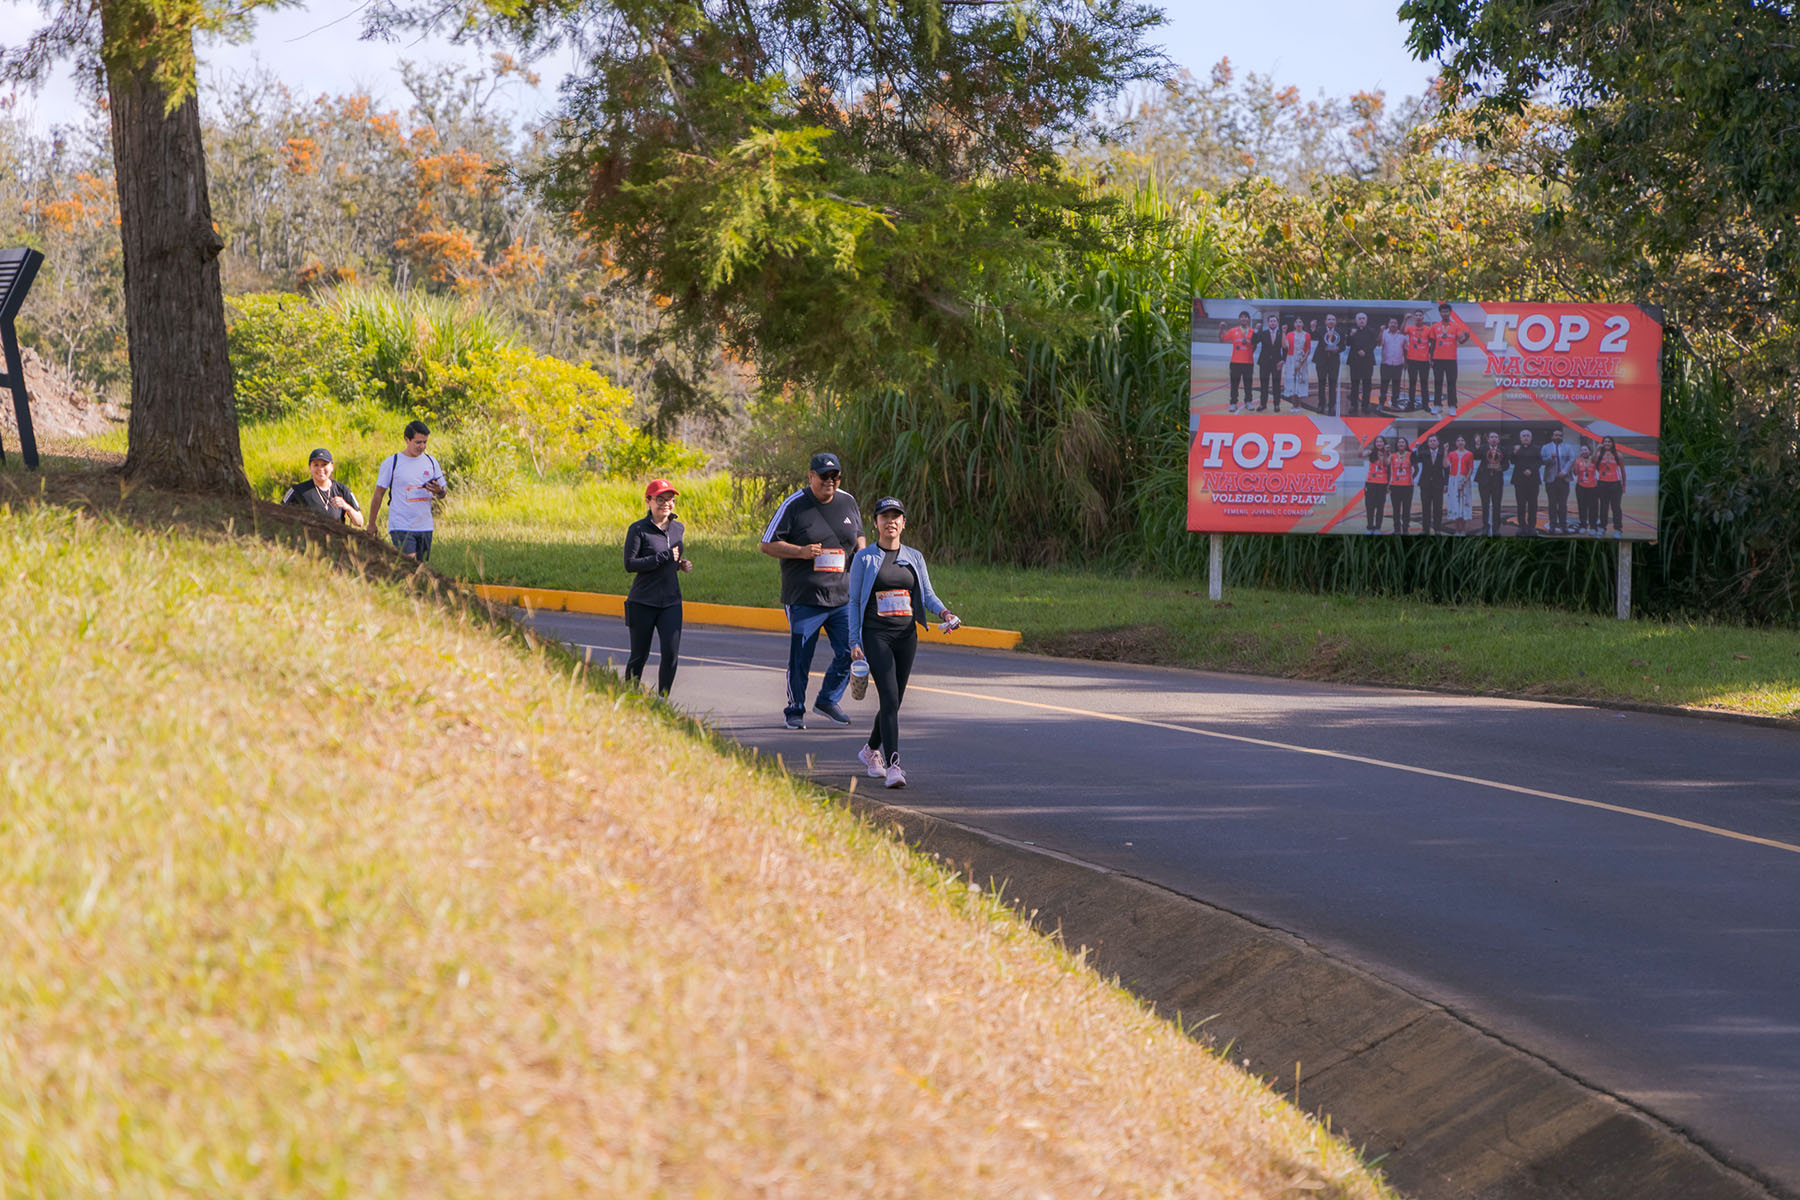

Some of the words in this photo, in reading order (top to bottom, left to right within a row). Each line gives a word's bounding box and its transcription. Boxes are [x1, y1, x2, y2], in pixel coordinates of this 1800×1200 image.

[1484, 313, 1590, 352] TOP
[1599, 315, 1630, 353] 2
[1484, 355, 1625, 378] NACIONAL
[1495, 378, 1555, 388] VOLEIBOL
[1558, 379, 1574, 388] DE
[1576, 379, 1615, 389] PLAYA
[1201, 431, 1302, 469] TOP
[1312, 433, 1343, 470] 3
[1200, 472, 1336, 493] NACIONAL
[1211, 494, 1269, 503] VOLEIBOL
[1272, 495, 1288, 504] DE
[1290, 495, 1327, 505] PLAYA
